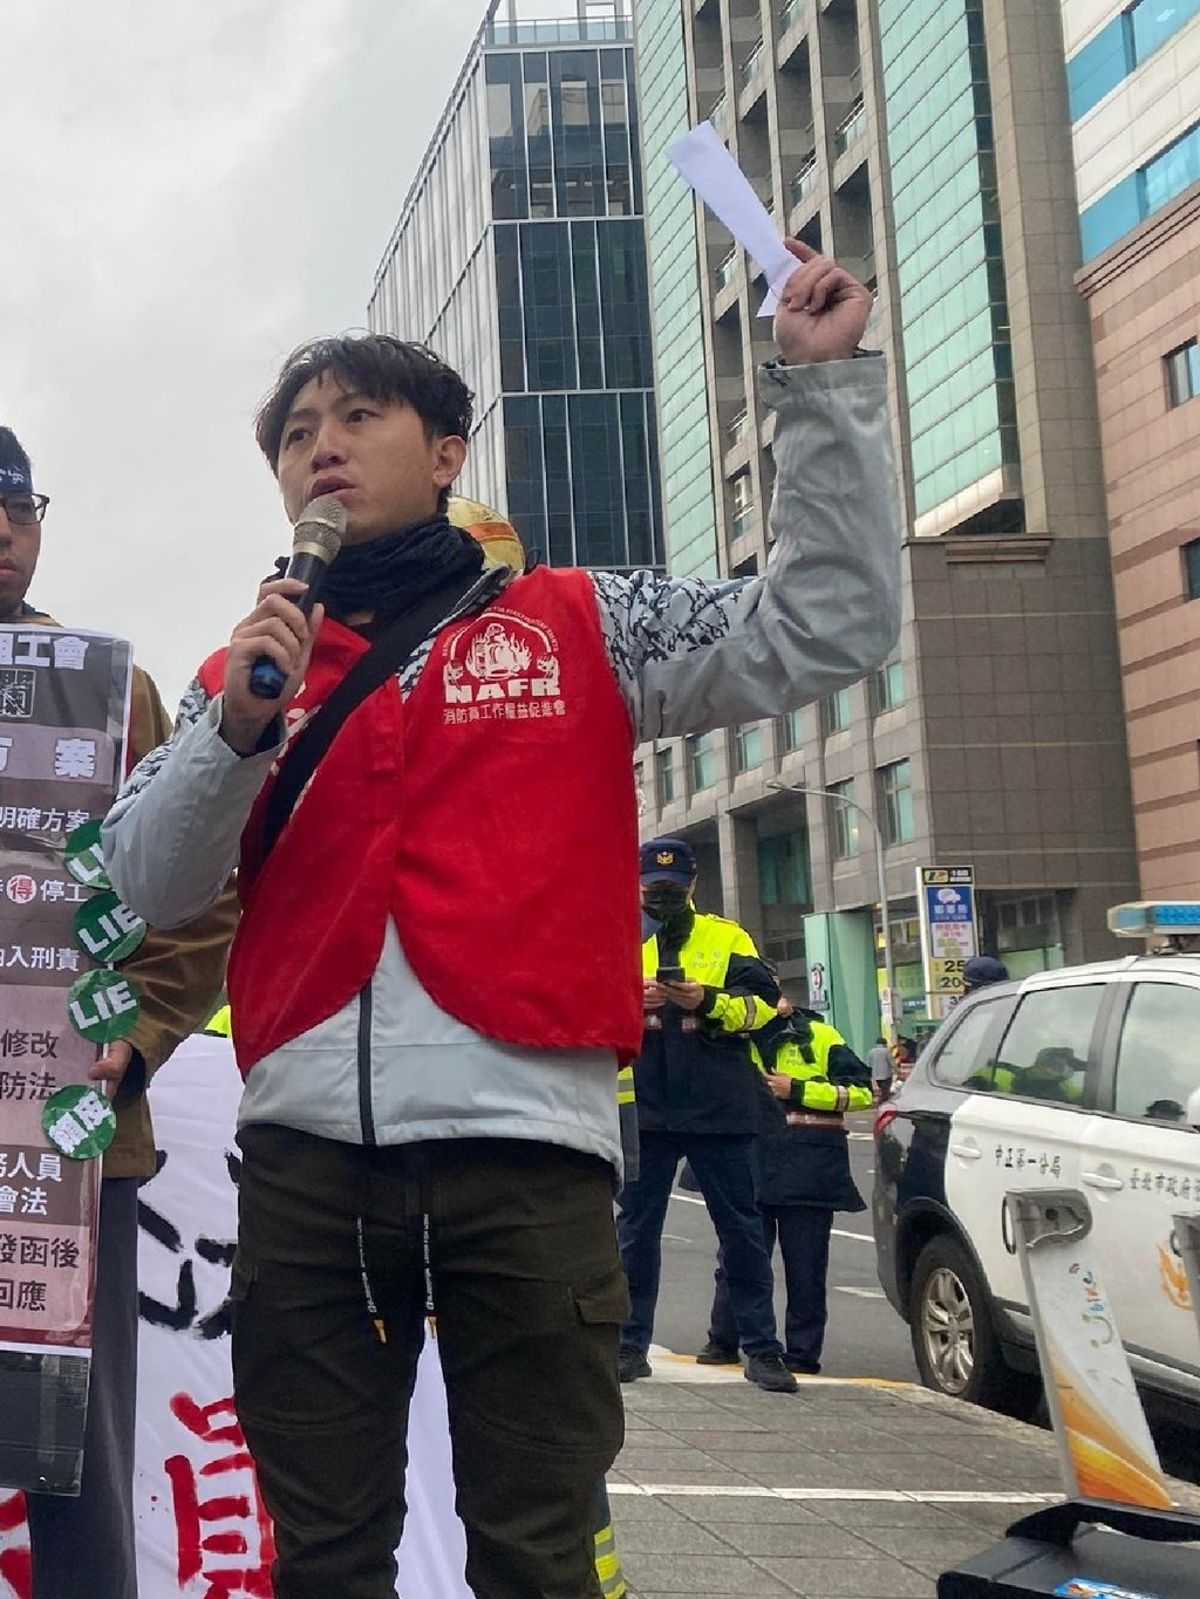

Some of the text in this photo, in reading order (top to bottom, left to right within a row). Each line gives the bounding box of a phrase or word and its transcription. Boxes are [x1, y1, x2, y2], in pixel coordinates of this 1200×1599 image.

[445, 677, 561, 704] NAFR
[78, 903, 143, 954] LIE
[69, 980, 137, 1030] LIE
